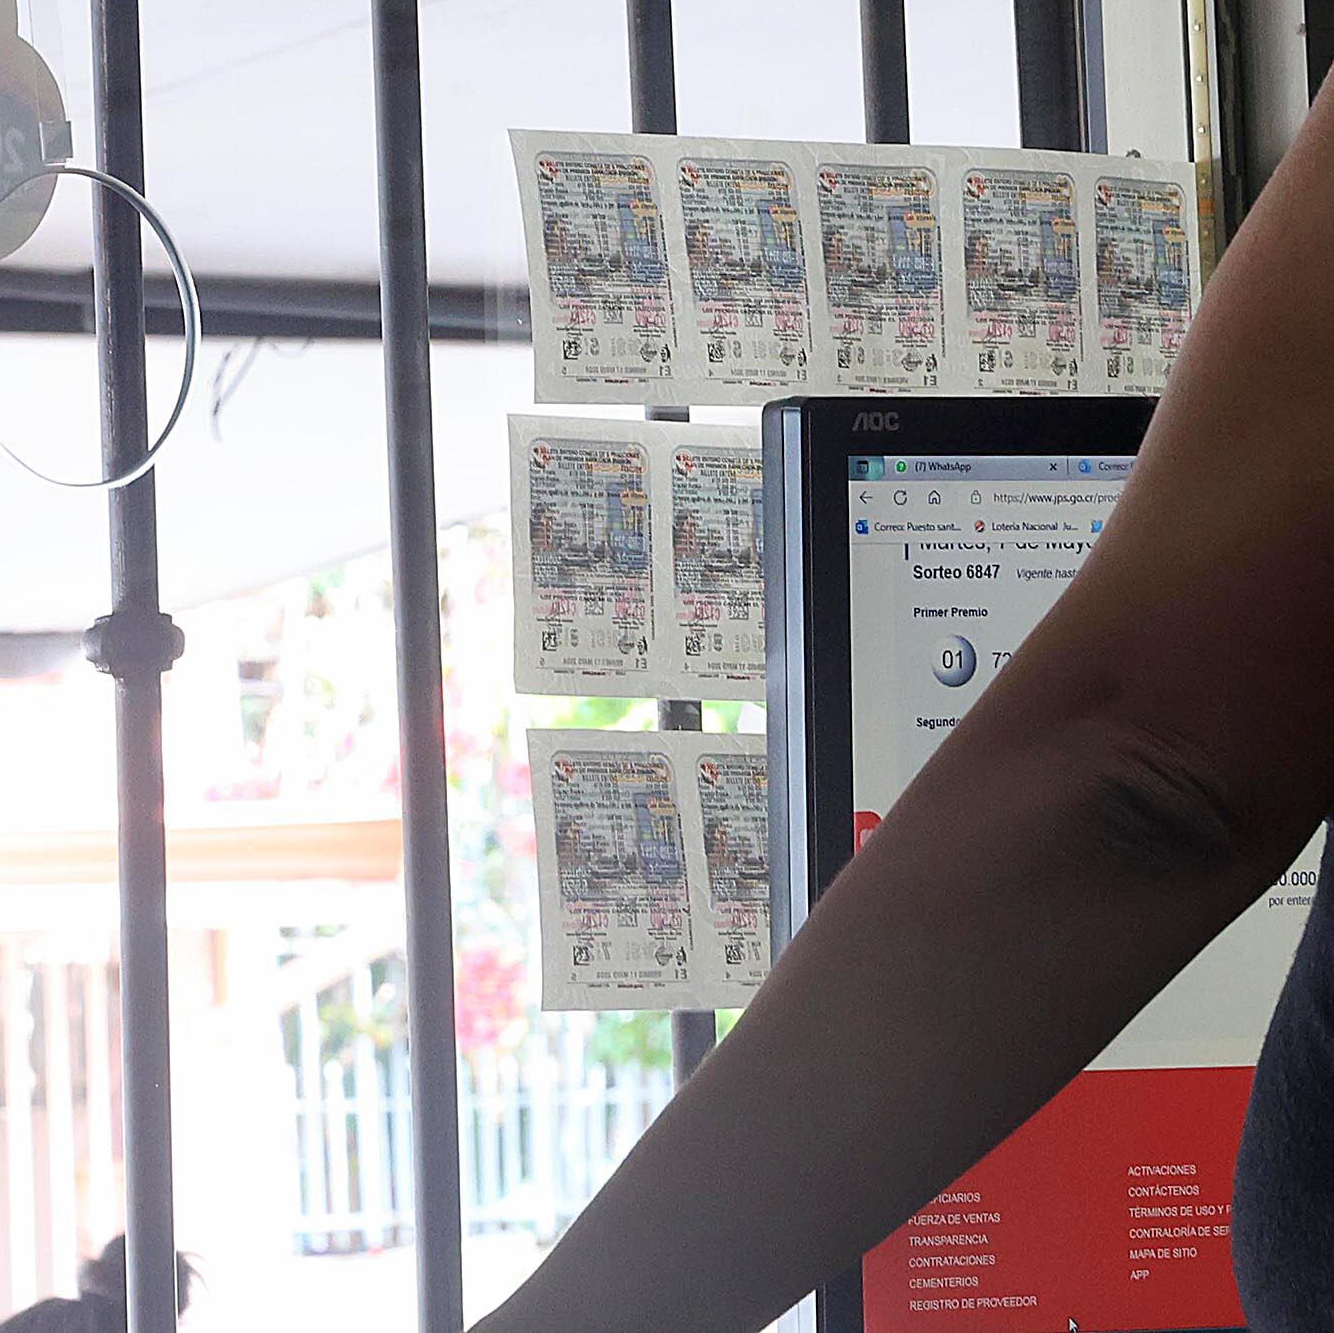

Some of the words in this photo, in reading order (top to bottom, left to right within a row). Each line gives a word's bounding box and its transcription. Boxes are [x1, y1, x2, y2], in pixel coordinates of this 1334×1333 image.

[852, 411, 900, 432] AOC
[929, 460, 972, 472] WhatsApp
[907, 521, 935, 533] Puesto
[1022, 520, 1058, 532] Nacional
[913, 565, 961, 580] Sorteo
[966, 563, 1000, 580] 6847
[1017, 568, 1053, 581] Vigente
[913, 607, 948, 618] Primer
[951, 607, 988, 618] Premio
[942, 649, 965, 670] 01
[1269, 897, 1284, 909] por
[1128, 1165, 1197, 1177] ACTIVACIONES
[1128, 1184, 1200, 1198] CONTÁCTENOS
[1129, 1206, 1178, 1219] TÉRMINOS
[1180, 1206, 1193, 1217] DE
[1195, 1206, 1216, 1217] USO
[1217, 1204, 1224, 1215] Y
[908, 1214, 947, 1226] FUERZA
[948, 1214, 961, 1225] DE
[963, 1212, 1000, 1224] VENTAS
[1129, 1224, 1197, 1239] CONTRALORÍA
[1198, 1227, 1211, 1237] DE
[909, 1234, 989, 1247] TRANSPARENCIA
[1129, 1249, 1156, 1259] MAPA
[1157, 1248, 1170, 1259] DE
[1172, 1247, 1197, 1258] SITIO
[909, 1255, 996, 1268] CONTRATACIONES
[1130, 1270, 1150, 1280] APP
[909, 1276, 979, 1289] CEMENTERIOS
[910, 1299, 959, 1311] REGISTRO
[961, 1298, 975, 1309] DE
[977, 1296, 1037, 1308] PROVEEDOR
